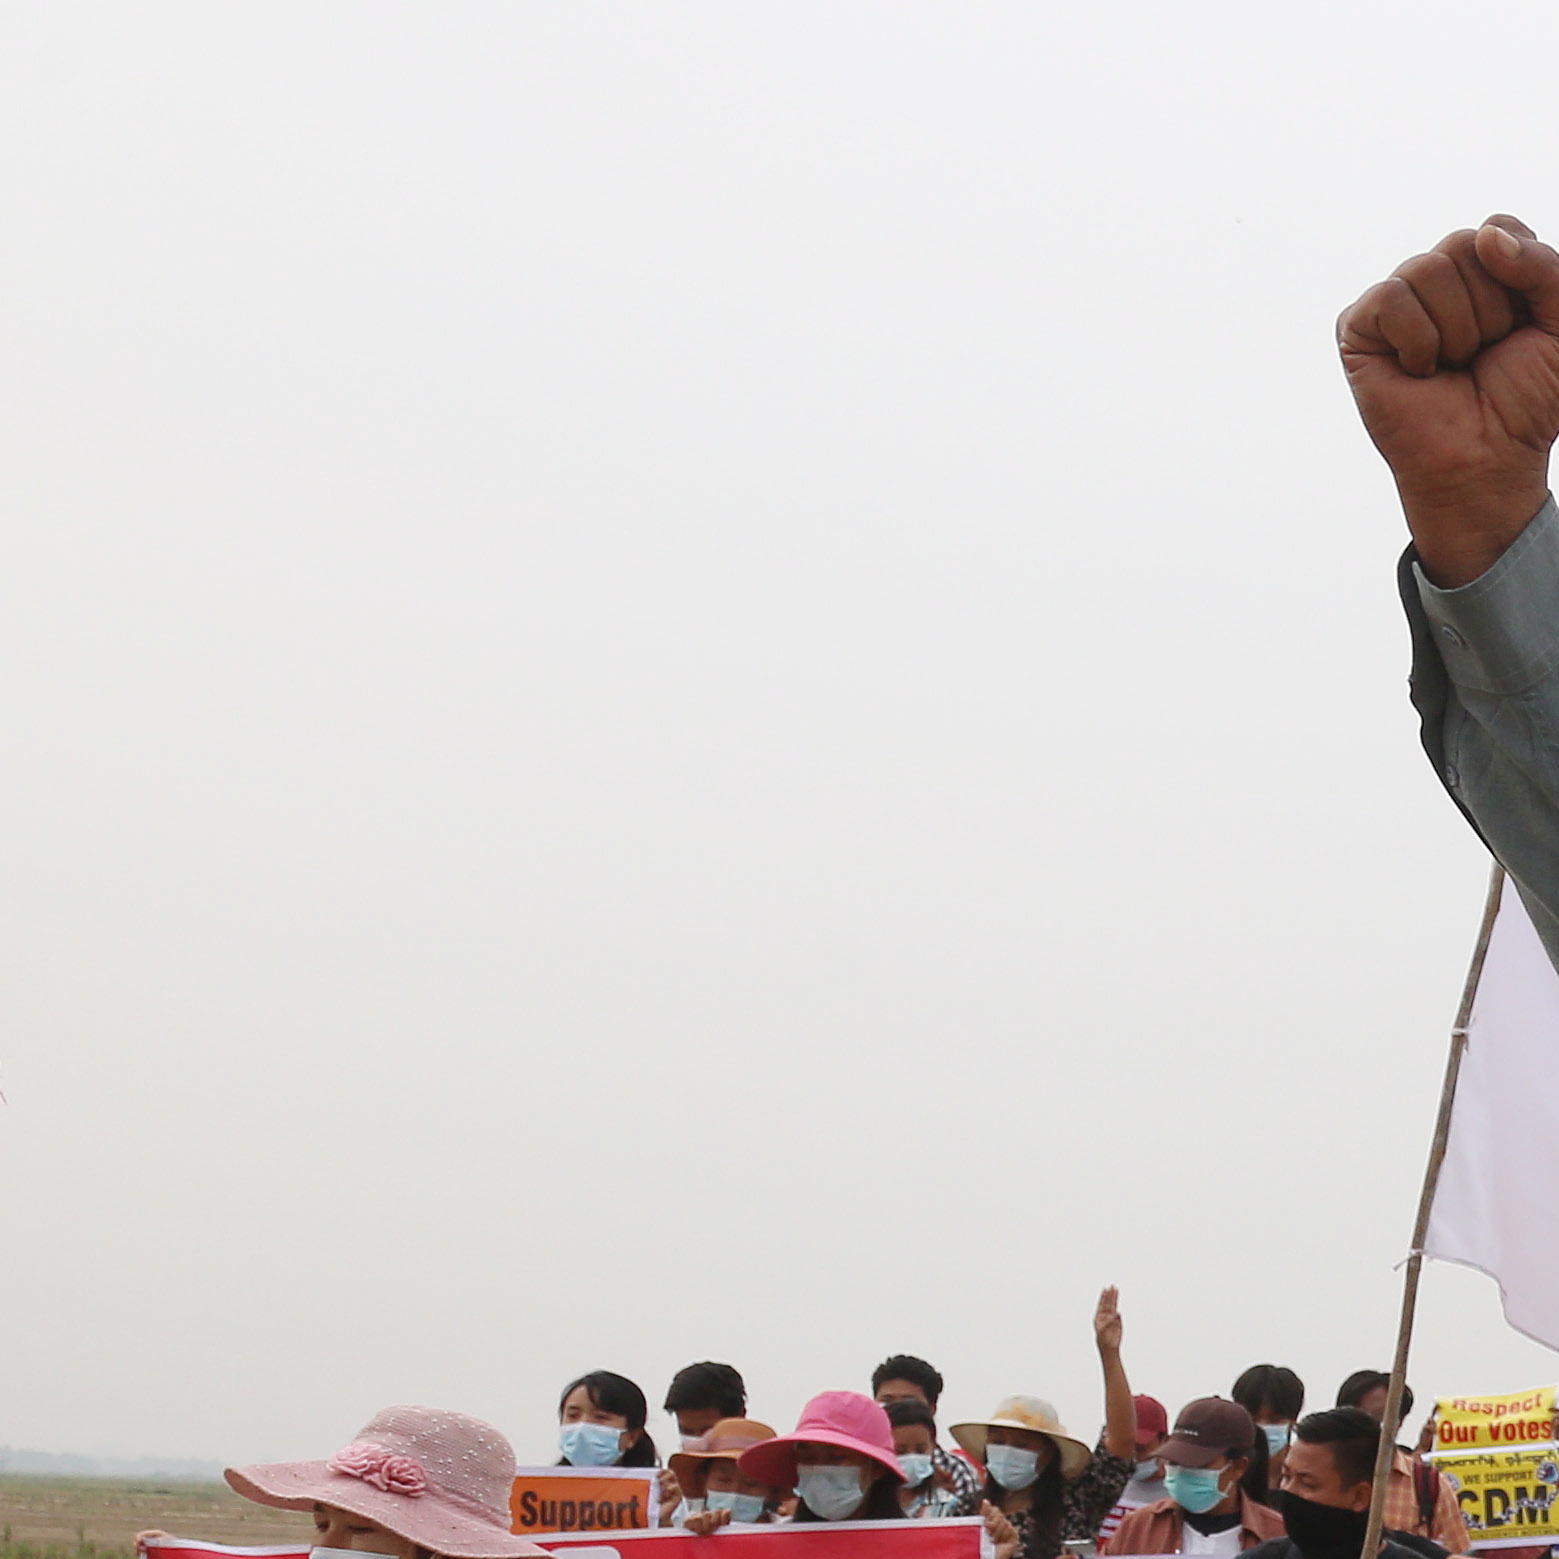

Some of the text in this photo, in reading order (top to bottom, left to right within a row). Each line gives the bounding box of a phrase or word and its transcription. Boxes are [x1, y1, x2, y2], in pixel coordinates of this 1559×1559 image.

[1452, 1393, 1543, 1418] Respect
[1439, 1420, 1478, 1443] Our
[1462, 1471, 1532, 1485] WE SUPPORT
[520, 1491, 640, 1531] Support
[1457, 1485, 1550, 1528] CDM
